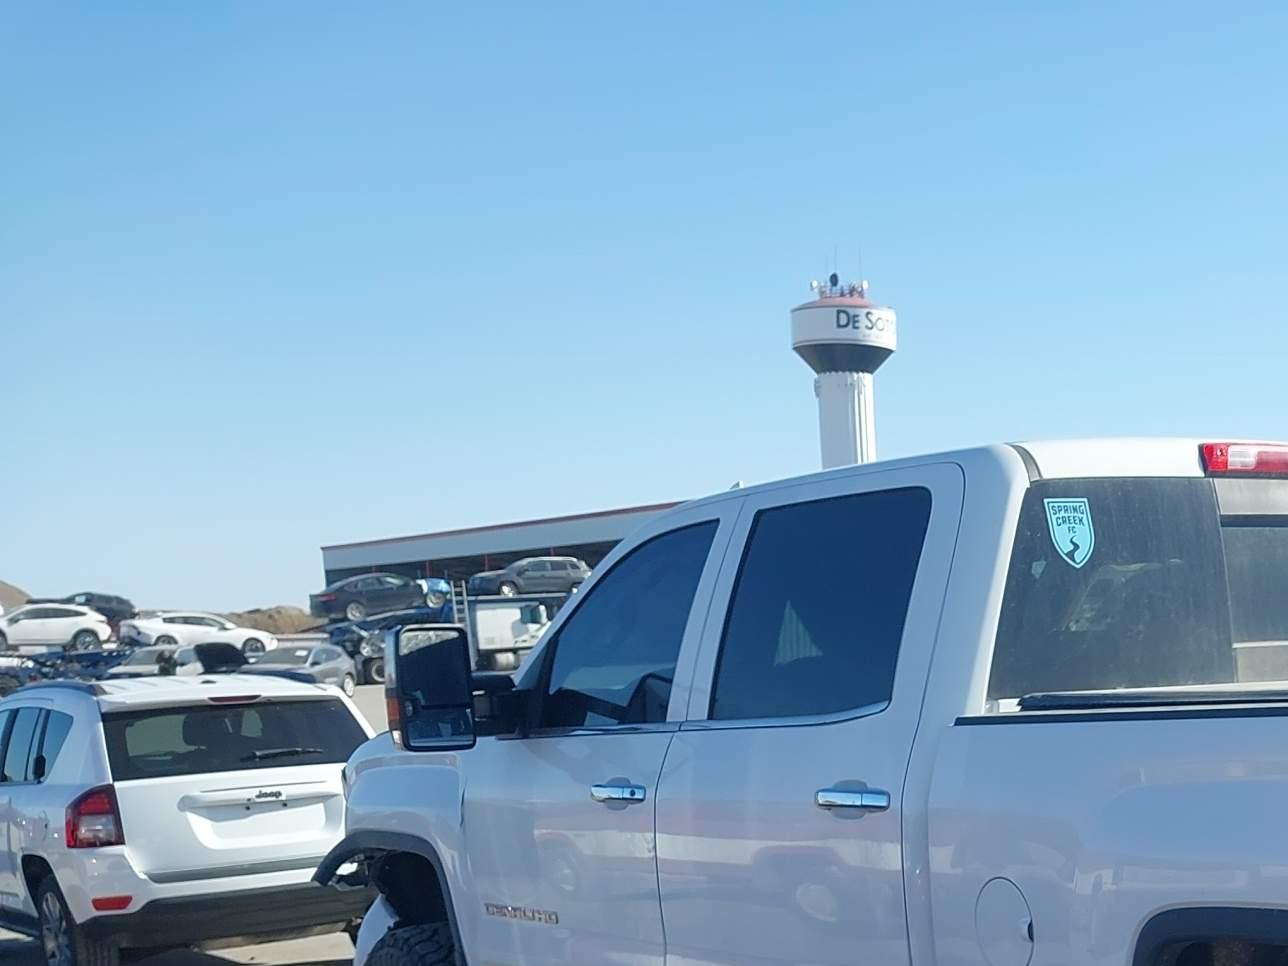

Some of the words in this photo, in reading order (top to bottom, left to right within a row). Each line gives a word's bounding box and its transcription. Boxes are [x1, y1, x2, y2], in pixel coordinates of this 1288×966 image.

[1051, 505, 1085, 516] SPRING
[1055, 515, 1085, 527] CREEK
[1067, 526, 1077, 534] FC
